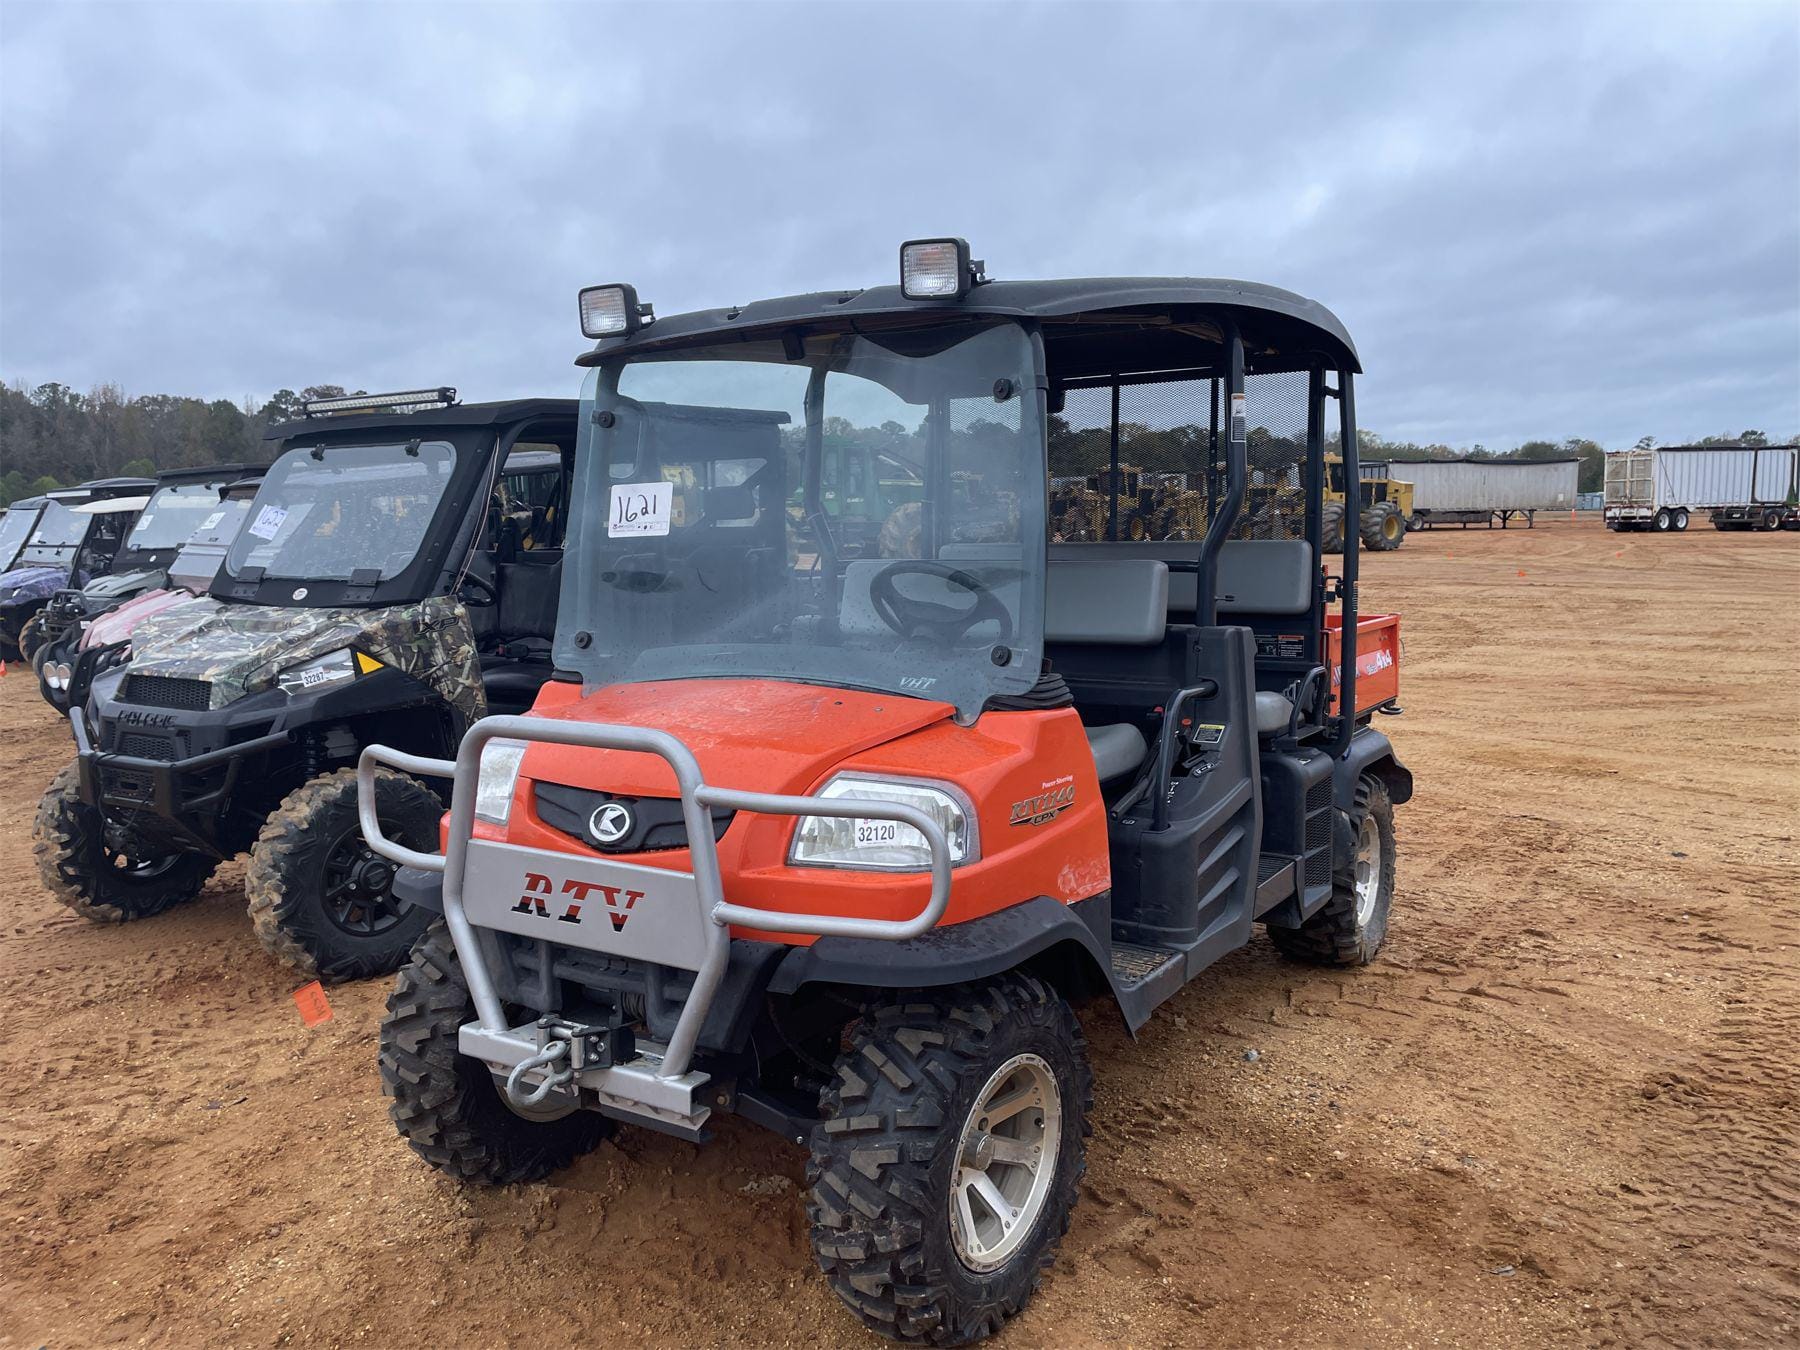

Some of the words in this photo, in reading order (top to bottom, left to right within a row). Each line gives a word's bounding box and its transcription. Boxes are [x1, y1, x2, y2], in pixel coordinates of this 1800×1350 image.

[618, 494, 657, 524] 1621
[417, 615, 460, 635] XP
[303, 671, 325, 685] 32287
[1033, 811, 1056, 825] CPX
[858, 825, 895, 842] 32120
[511, 872, 645, 932] RTV
